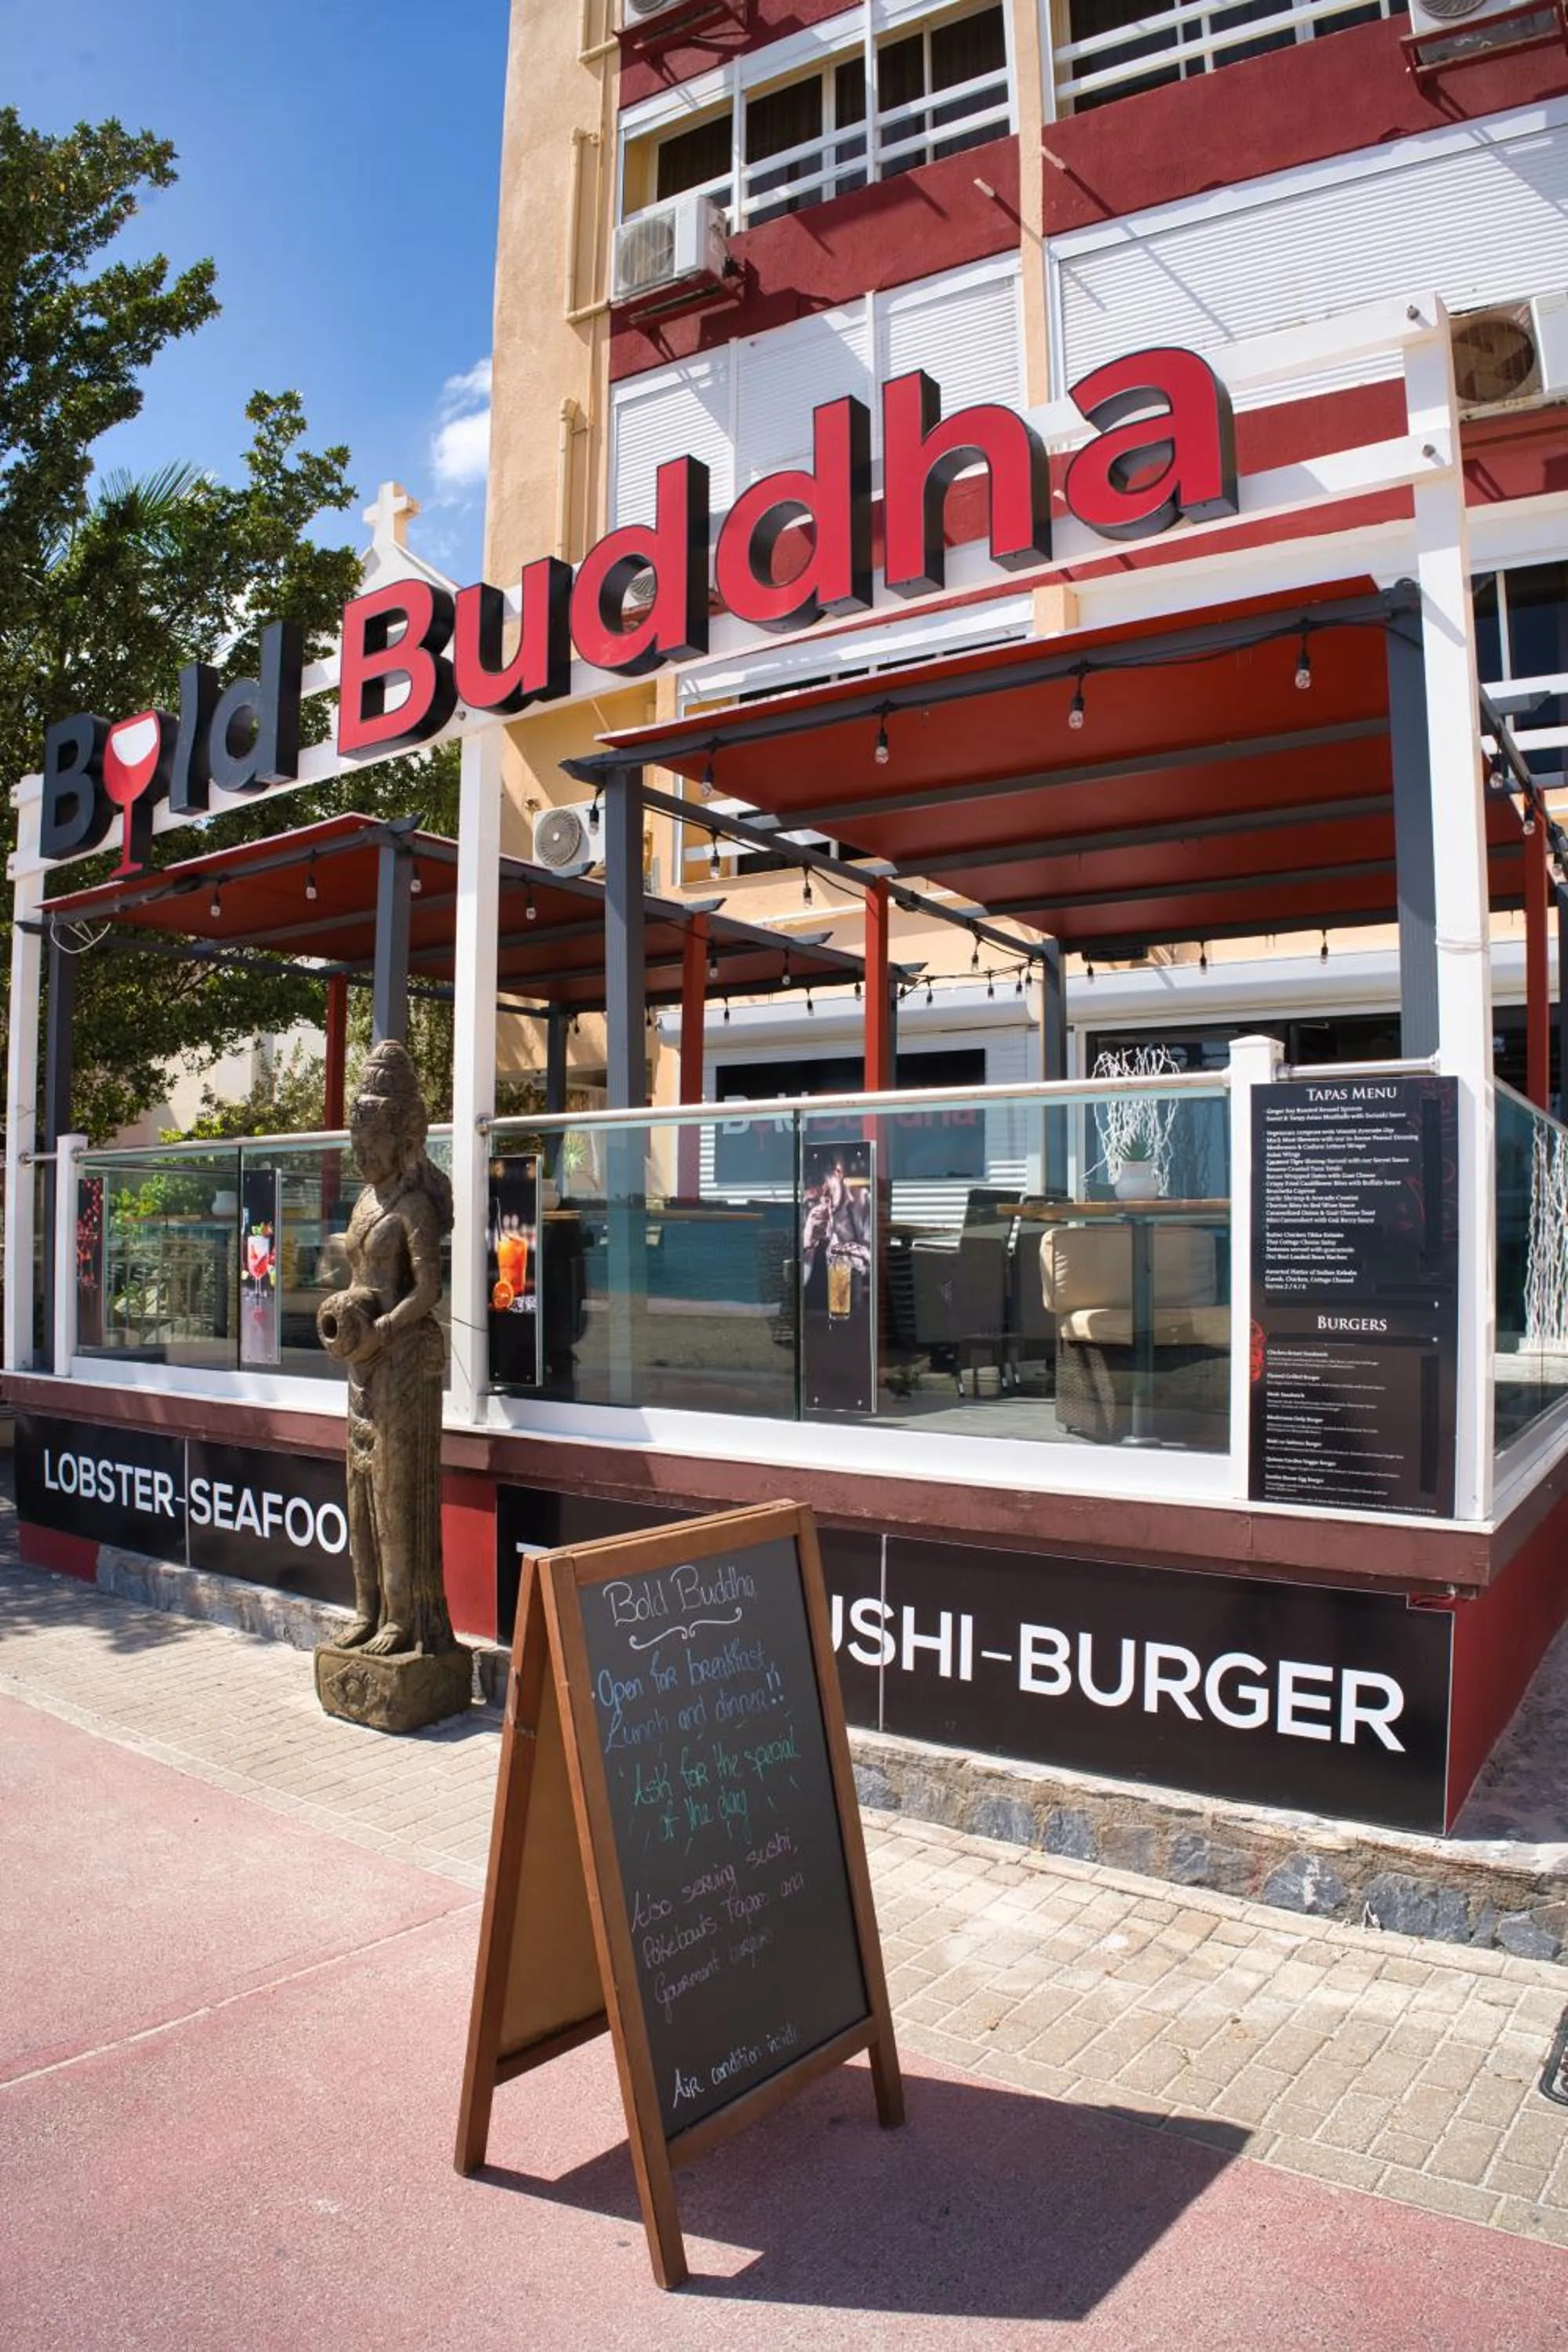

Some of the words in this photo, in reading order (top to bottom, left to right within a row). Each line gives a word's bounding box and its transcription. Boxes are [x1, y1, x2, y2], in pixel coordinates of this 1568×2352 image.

[337, 347, 1239, 757] Buddha
[1306, 1087, 1348, 1101] TAPAS
[1352, 1087, 1396, 1099] MENU
[1317, 1316, 1387, 1331] BURGERS
[44, 1449, 352, 1555] LOBSTER-SEAFOO
[603, 1581, 670, 1628] Bold
[670, 1565, 758, 1611] Buddha
[597, 1669, 643, 1712] Open
[678, 1696, 706, 1731] and
